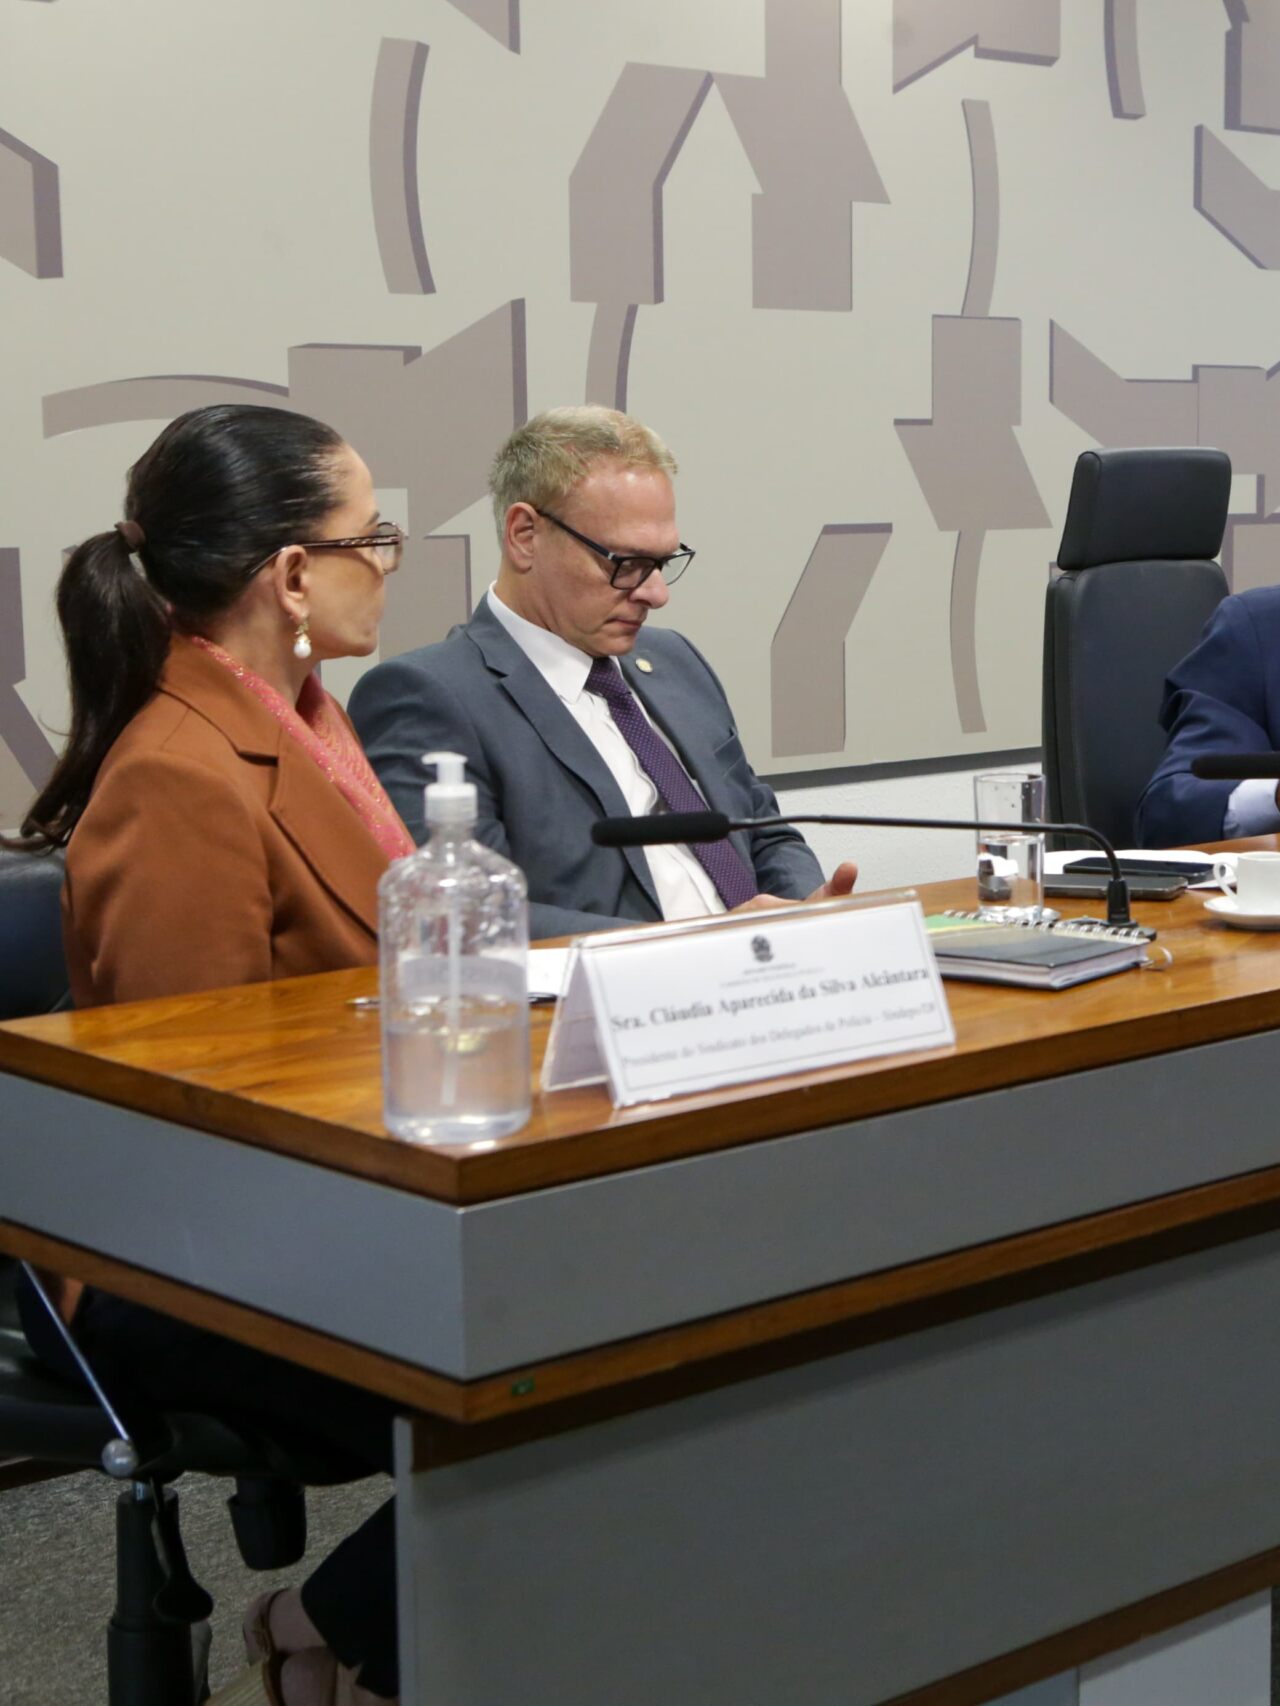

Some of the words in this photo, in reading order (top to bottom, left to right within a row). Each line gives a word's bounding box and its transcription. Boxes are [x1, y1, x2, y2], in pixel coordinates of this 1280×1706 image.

[610, 1014, 645, 1032] Sra.
[649, 1001, 714, 1027] Cláudia
[719, 989, 795, 1016] Aparecida
[798, 984, 816, 1001] da
[819, 978, 857, 995] Silva
[861, 968, 929, 989] Alcântara
